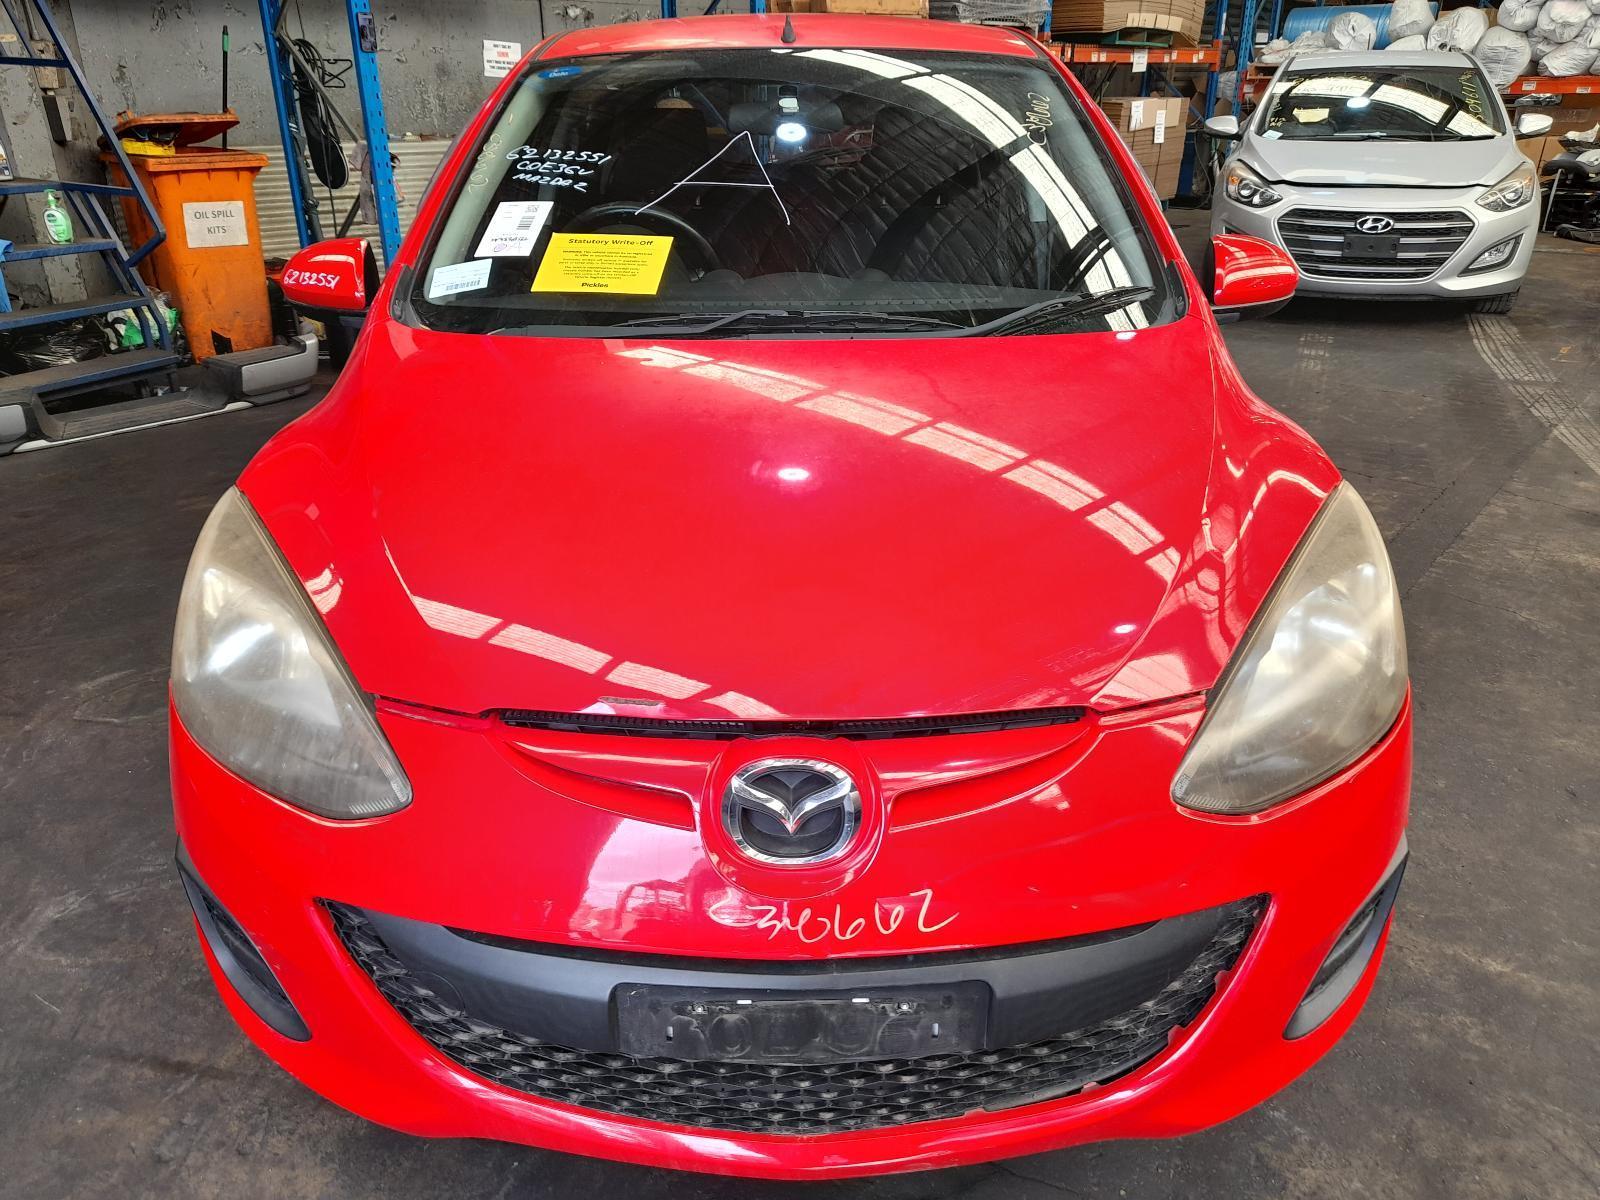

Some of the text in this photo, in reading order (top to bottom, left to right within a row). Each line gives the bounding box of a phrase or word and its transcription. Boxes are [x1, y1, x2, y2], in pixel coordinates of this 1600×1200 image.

[194, 210, 236, 220] OIL SPILL
[207, 225, 227, 234] KITS
[568, 238, 609, 246] Statutory
[284, 268, 341, 290] 62132551
